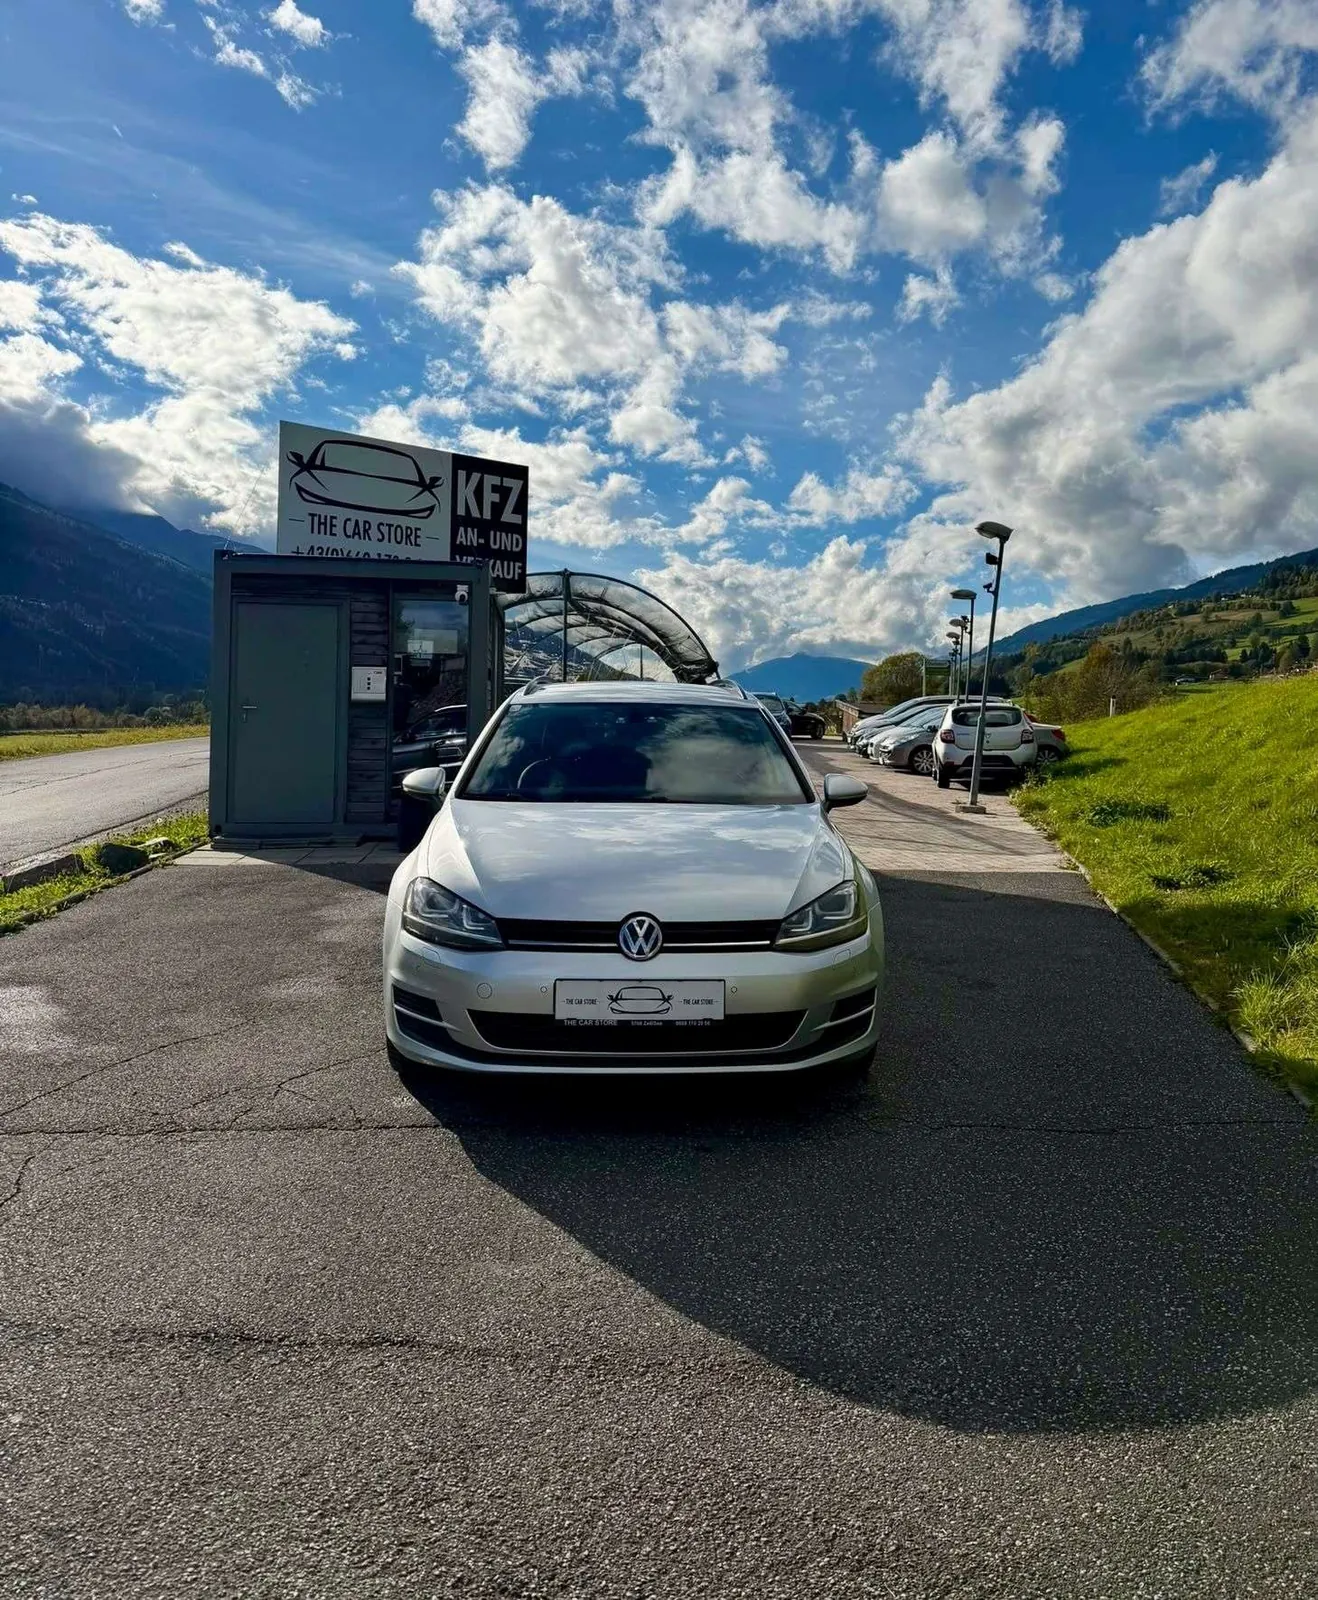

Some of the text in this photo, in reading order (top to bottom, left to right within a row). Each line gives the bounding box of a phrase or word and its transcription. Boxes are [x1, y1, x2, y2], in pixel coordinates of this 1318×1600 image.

[457, 470, 524, 524] KFZ
[308, 512, 422, 547] THE CAR STORE
[456, 526, 523, 552] AN- UND
[455, 554, 523, 580] KAUF
[620, 916, 662, 960] VW
